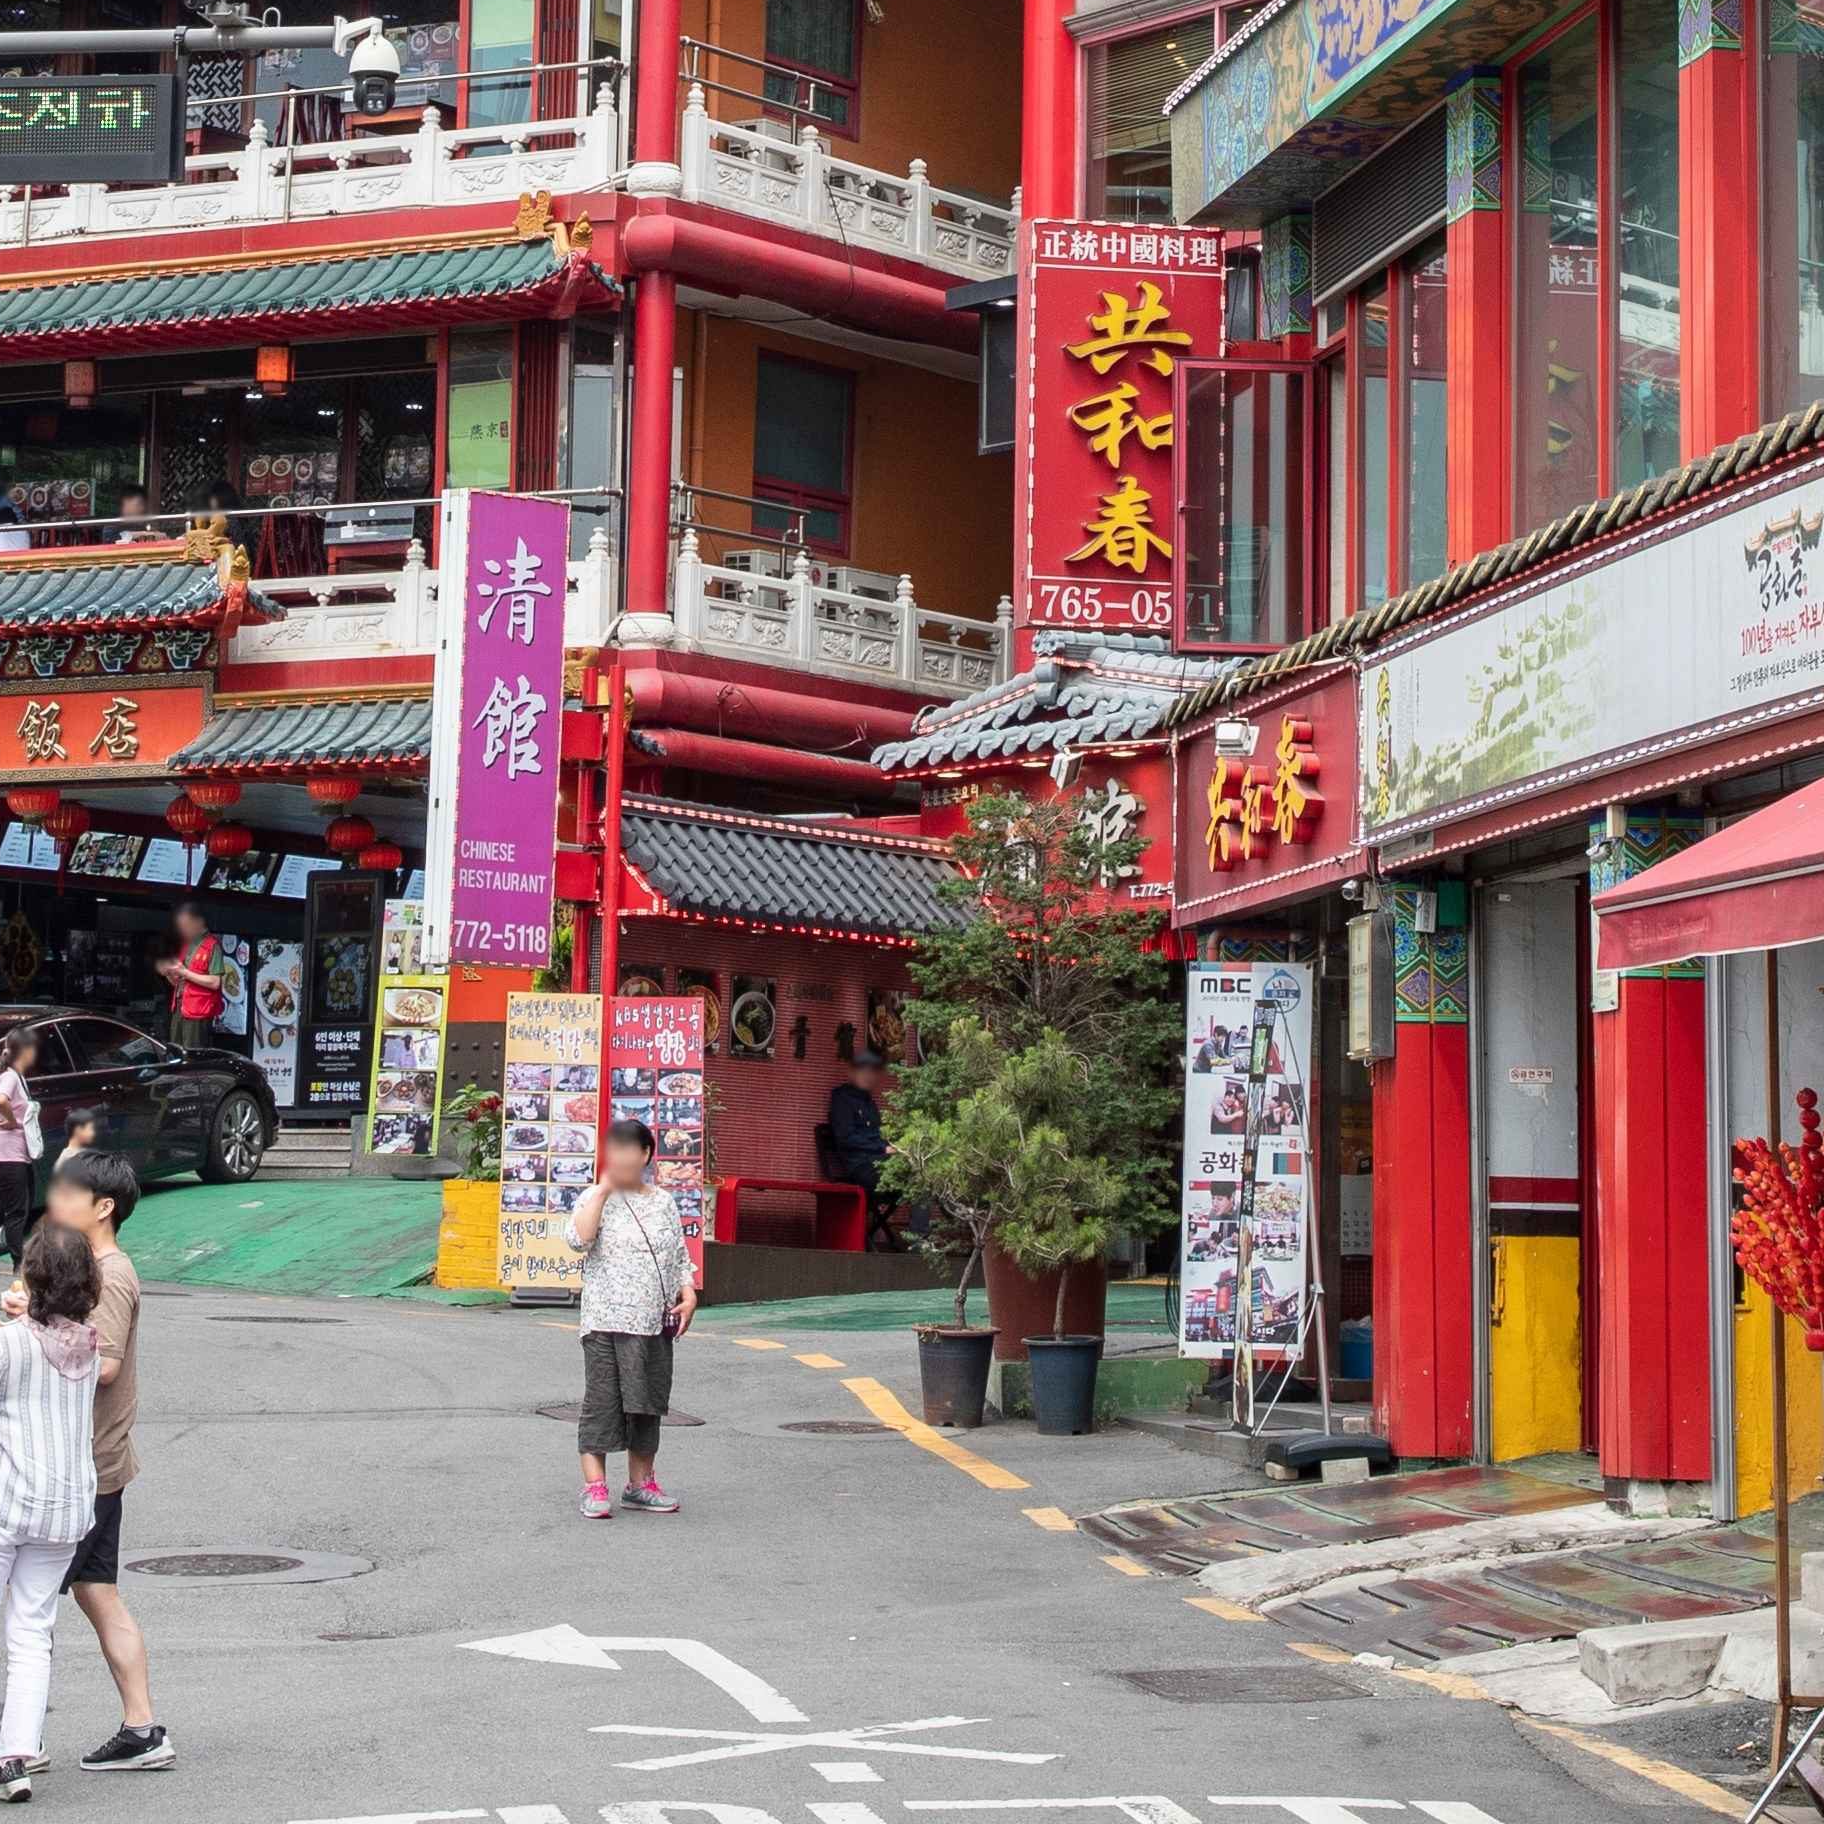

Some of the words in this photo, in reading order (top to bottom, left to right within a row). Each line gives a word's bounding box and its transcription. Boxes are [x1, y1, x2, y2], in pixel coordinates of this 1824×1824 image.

[1040, 230, 1218, 267] 正統中國料理
[1061, 279, 1194, 574] 共和春
[461, 840, 515, 864] CHINESE
[459, 868, 547, 894] RESTAURANT
[454, 920, 547, 954] 772-5118
[1201, 978, 1252, 994] MBC
[1199, 1151, 1243, 1175] 공화
